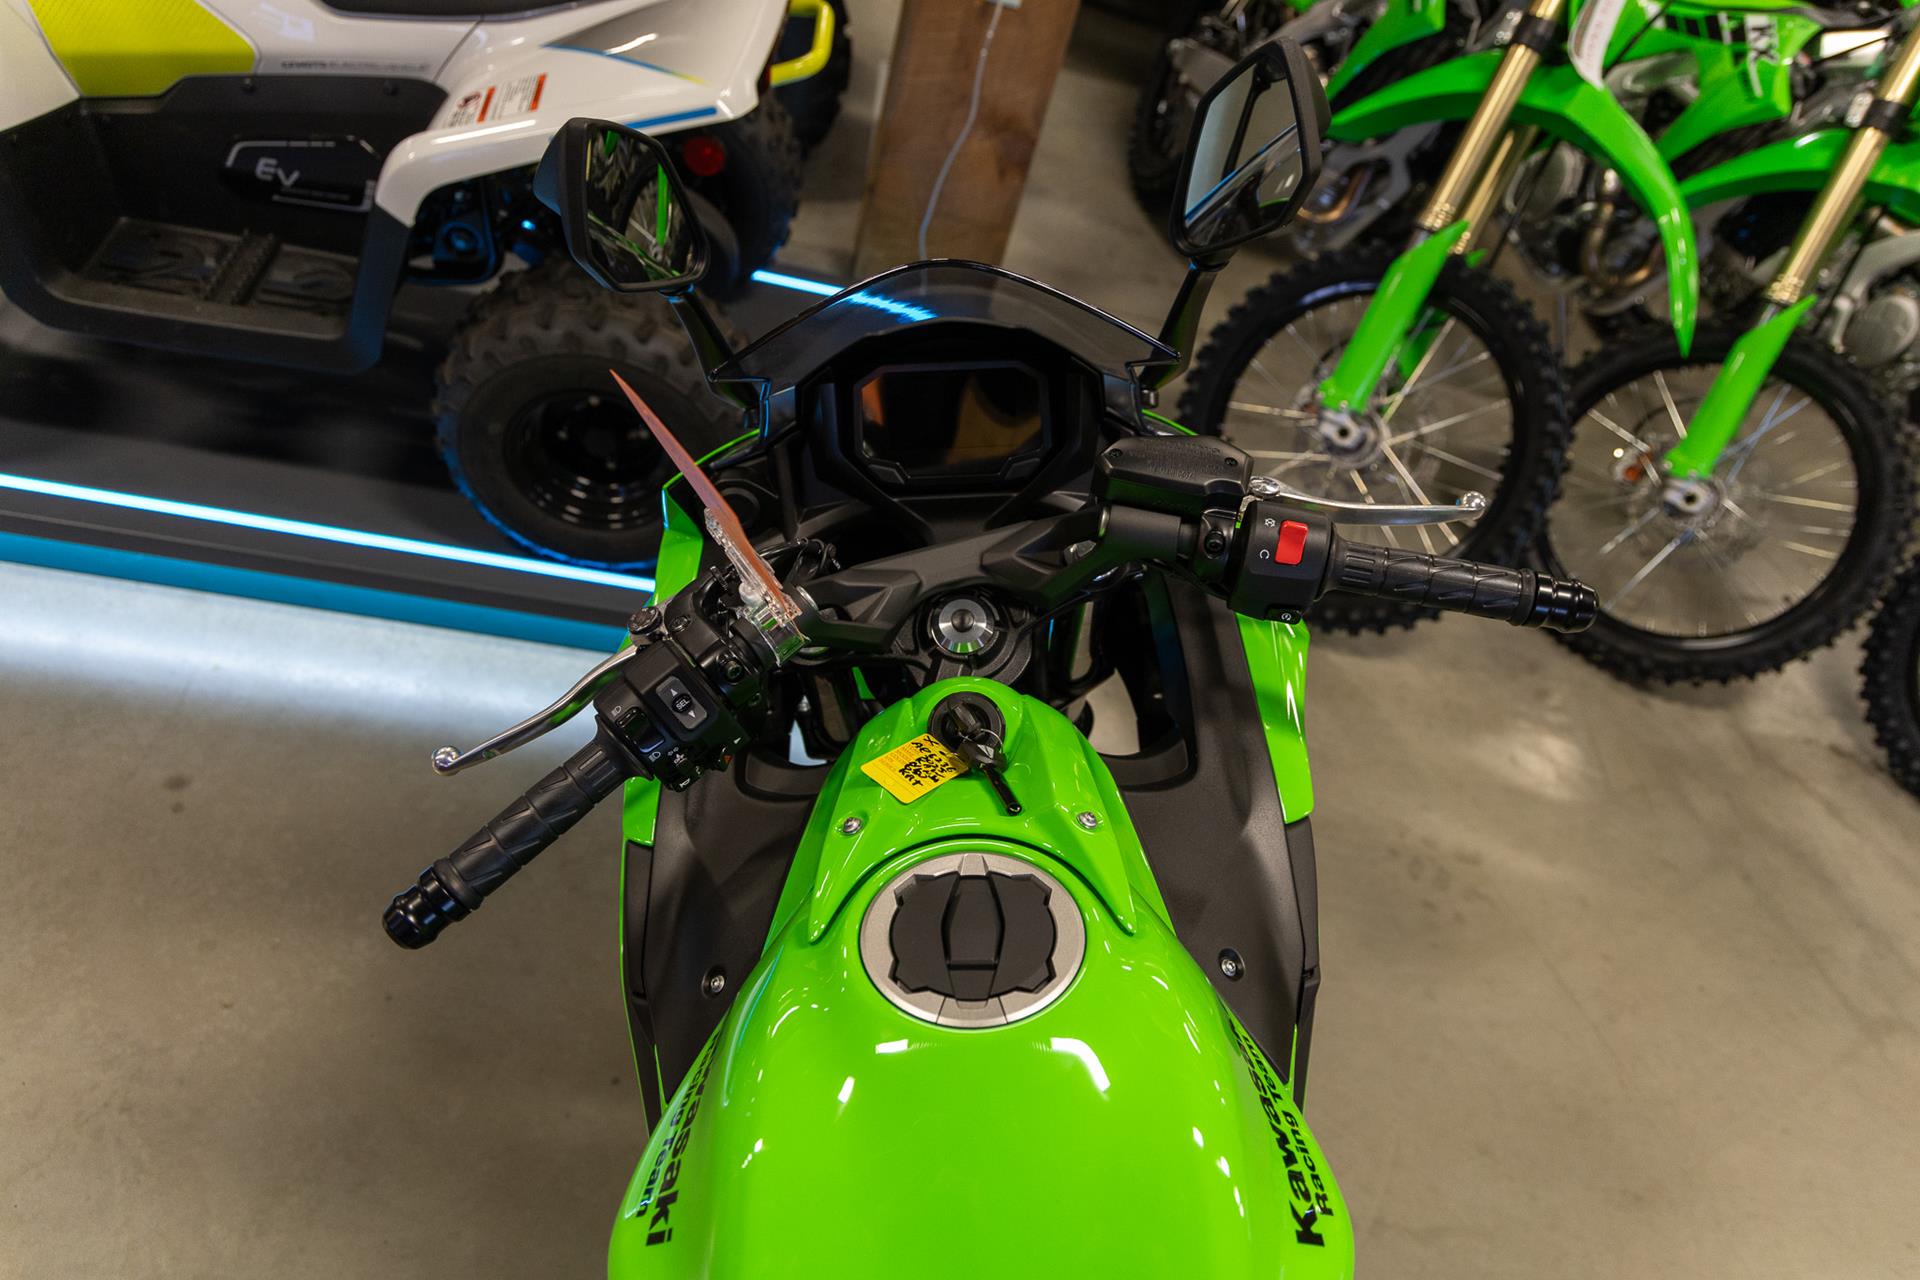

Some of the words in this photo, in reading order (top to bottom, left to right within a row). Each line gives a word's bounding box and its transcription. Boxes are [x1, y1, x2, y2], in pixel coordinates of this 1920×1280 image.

[255, 157, 300, 186] EV
[675, 698, 690, 710] SEL
[1229, 1017, 1325, 1248] Kawasa
[1282, 1109, 1334, 1217] Racing
